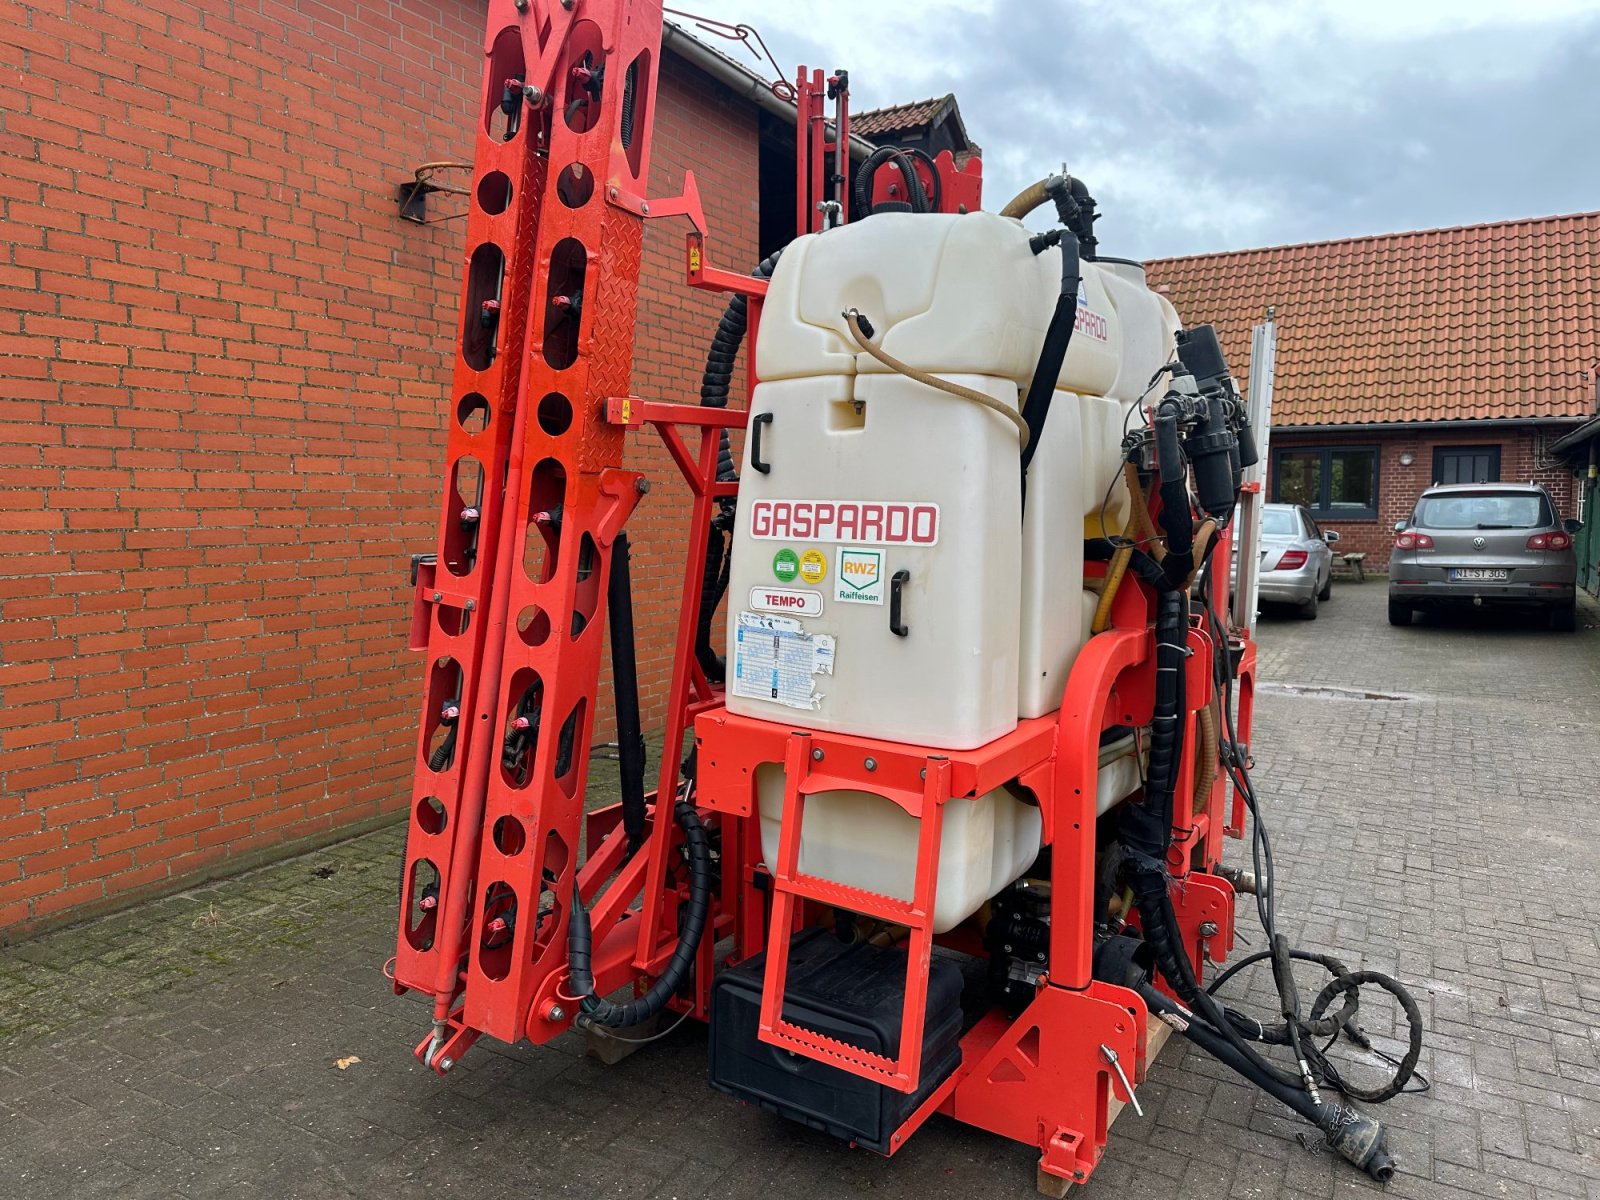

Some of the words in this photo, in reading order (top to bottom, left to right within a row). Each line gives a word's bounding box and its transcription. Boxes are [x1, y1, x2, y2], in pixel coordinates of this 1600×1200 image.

[752, 502, 937, 543] GASPARDO
[844, 561, 877, 575] RWZ
[1488, 569, 1506, 578] 303
[765, 594, 806, 608] TEMPO
[839, 590, 879, 602] Raiffeisen
